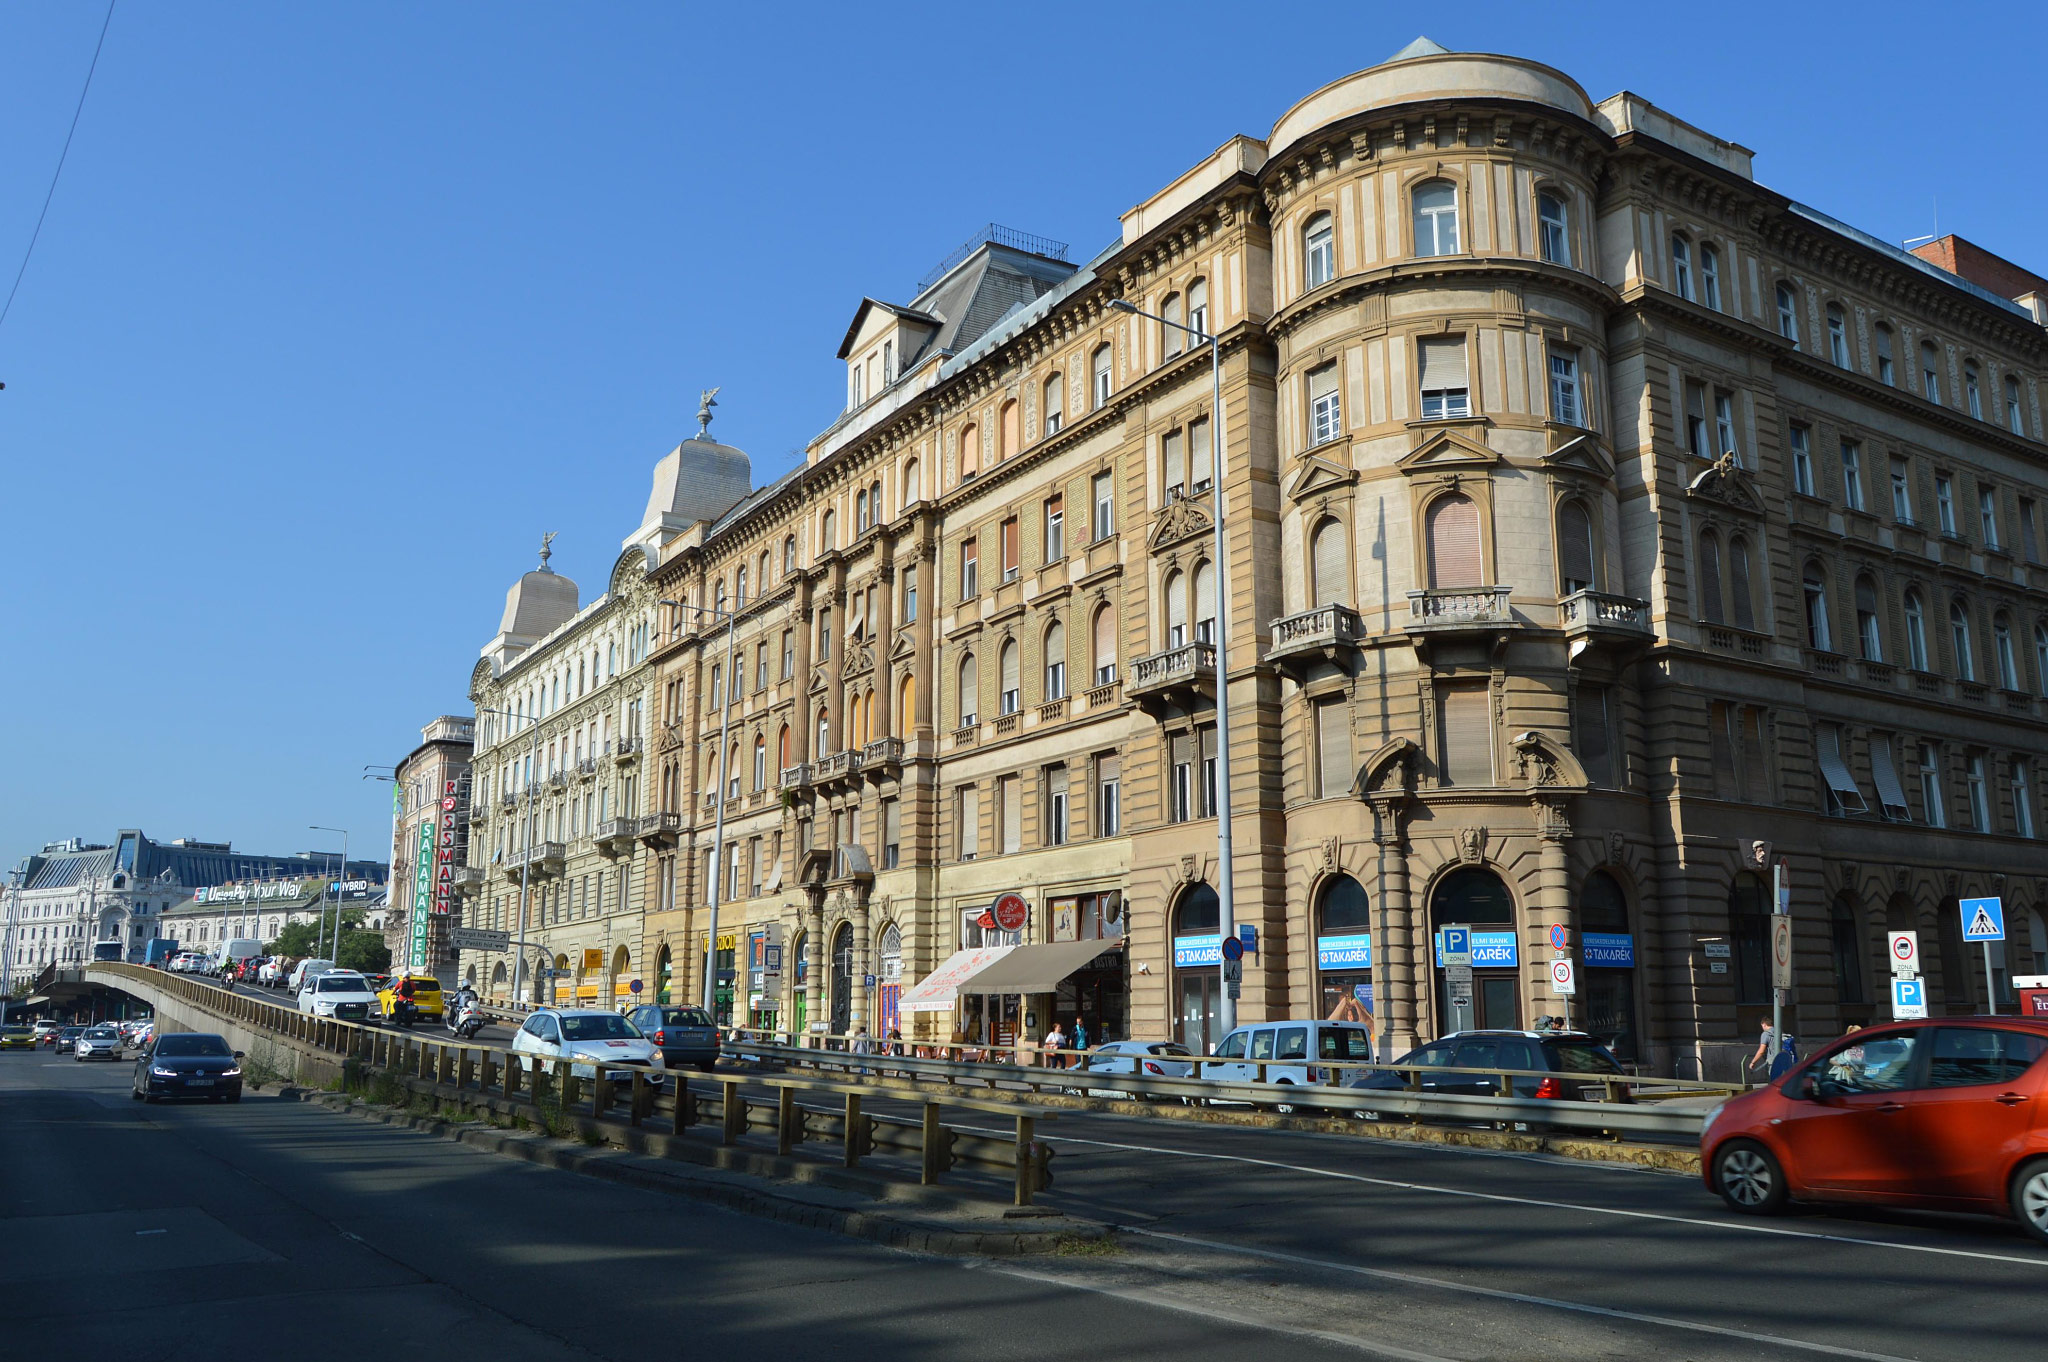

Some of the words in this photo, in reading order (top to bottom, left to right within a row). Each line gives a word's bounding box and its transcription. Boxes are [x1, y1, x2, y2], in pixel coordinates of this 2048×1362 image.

[254, 883, 276, 898] Your
[279, 881, 302, 900] Way
[413, 824, 430, 966] SALAMANDER
[457, 930, 476, 939] Margit
[1449, 932, 1463, 951] P
[1328, 948, 1368, 962] TAKARÉK
[1593, 947, 1631, 960] TAKARÉK
[1094, 955, 1118, 968] BISTRO
[1558, 969, 1566, 977] 30
[1901, 984, 1915, 1003] P
